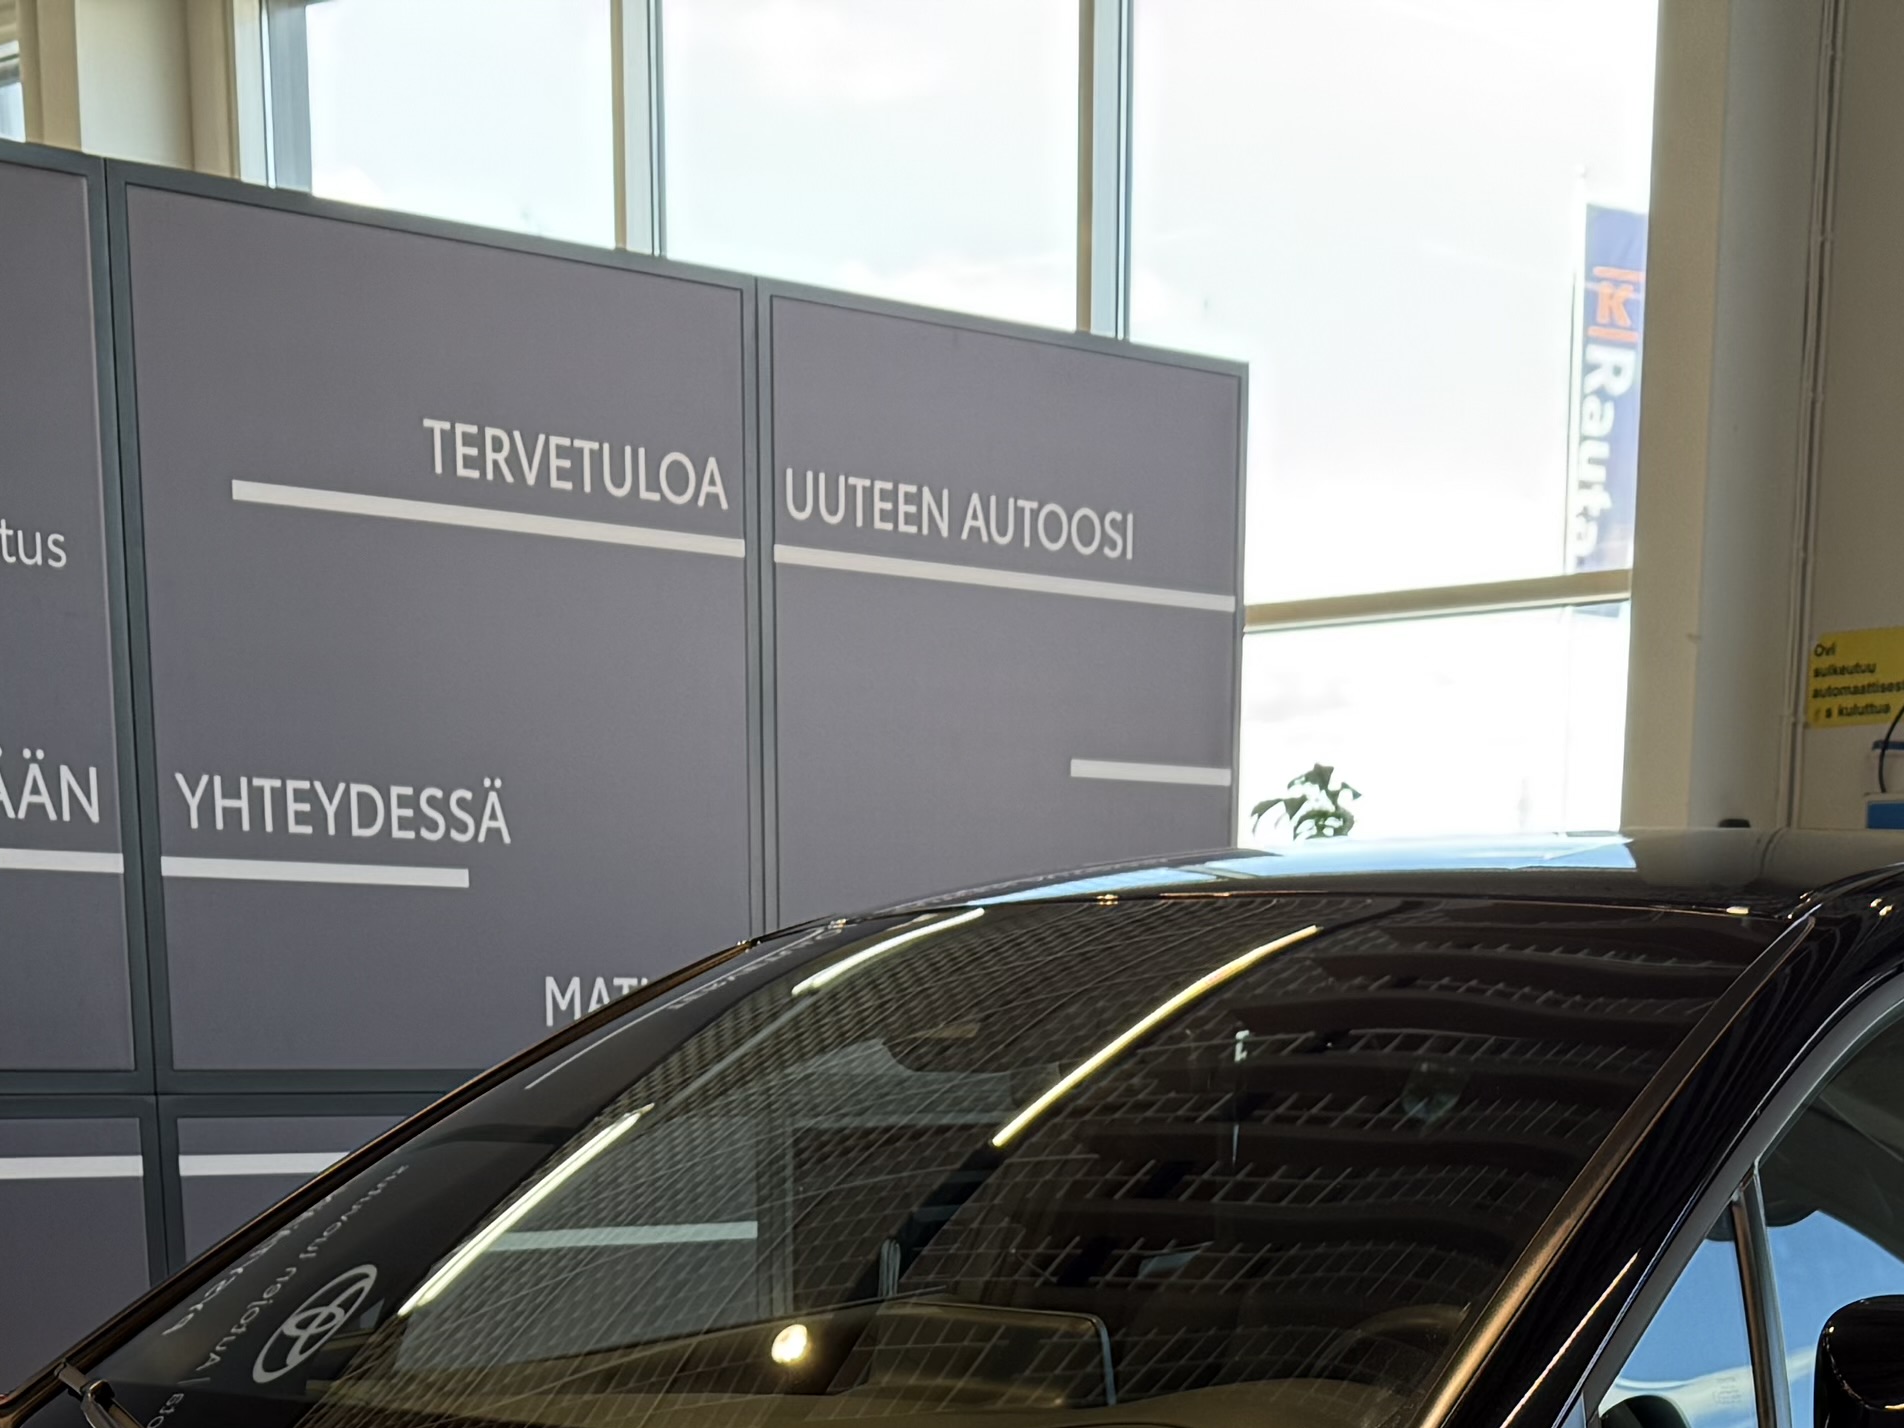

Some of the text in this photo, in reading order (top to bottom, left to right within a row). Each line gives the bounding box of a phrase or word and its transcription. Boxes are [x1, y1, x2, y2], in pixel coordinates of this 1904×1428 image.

[422, 416, 1136, 561] TERVETULOA UUTEEN AUTOOSI
[1576, 343, 1637, 559] Rauta
[174, 771, 511, 845] YHTEYDESSÄ
[544, 975, 650, 1028] MAT
